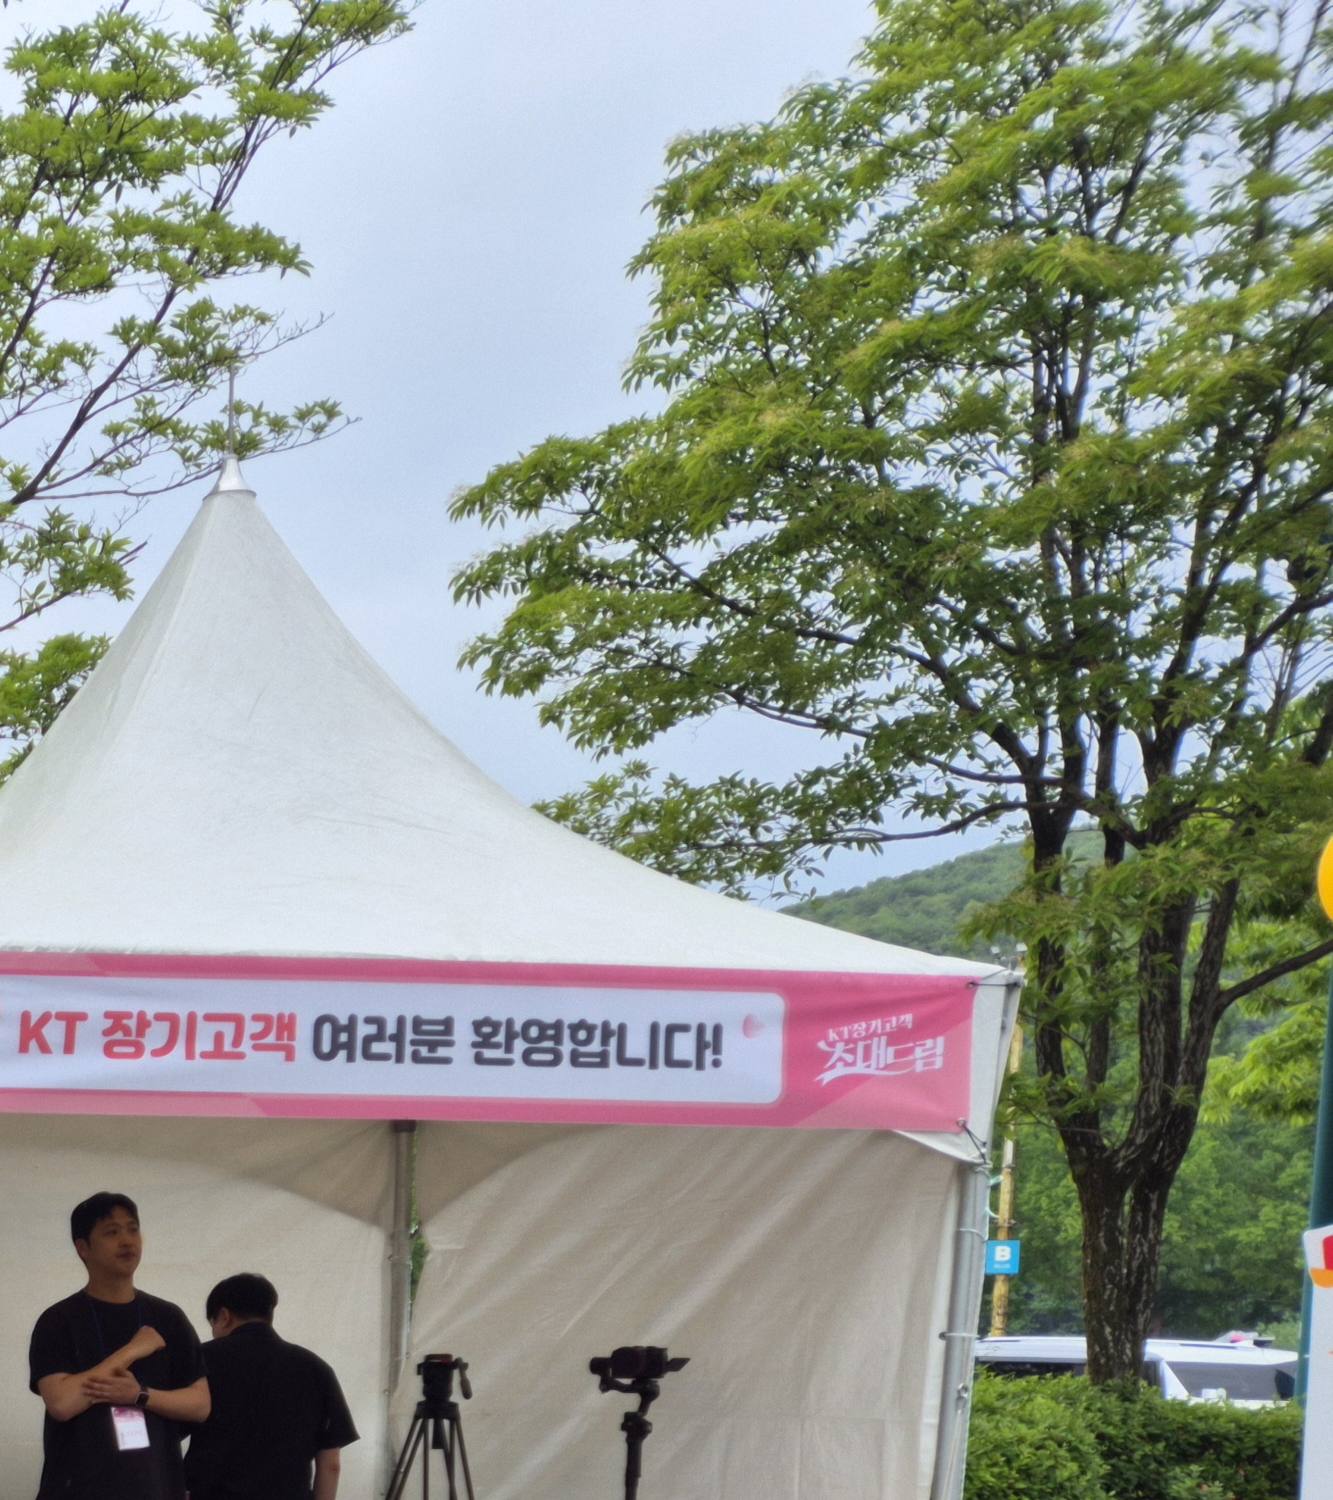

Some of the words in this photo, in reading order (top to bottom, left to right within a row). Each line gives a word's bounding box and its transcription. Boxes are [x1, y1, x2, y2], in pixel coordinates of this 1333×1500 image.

[18, 1010, 89, 1055] KT
[101, 1010, 297, 1063] 장기고객
[312, 1013, 455, 1065] 여러분
[471, 1016, 724, 1071] 환영합니다!
[827, 1013, 913, 1042] KT장기고객
[813, 1035, 946, 1087] 초대드림
[995, 1246, 1011, 1261] B
